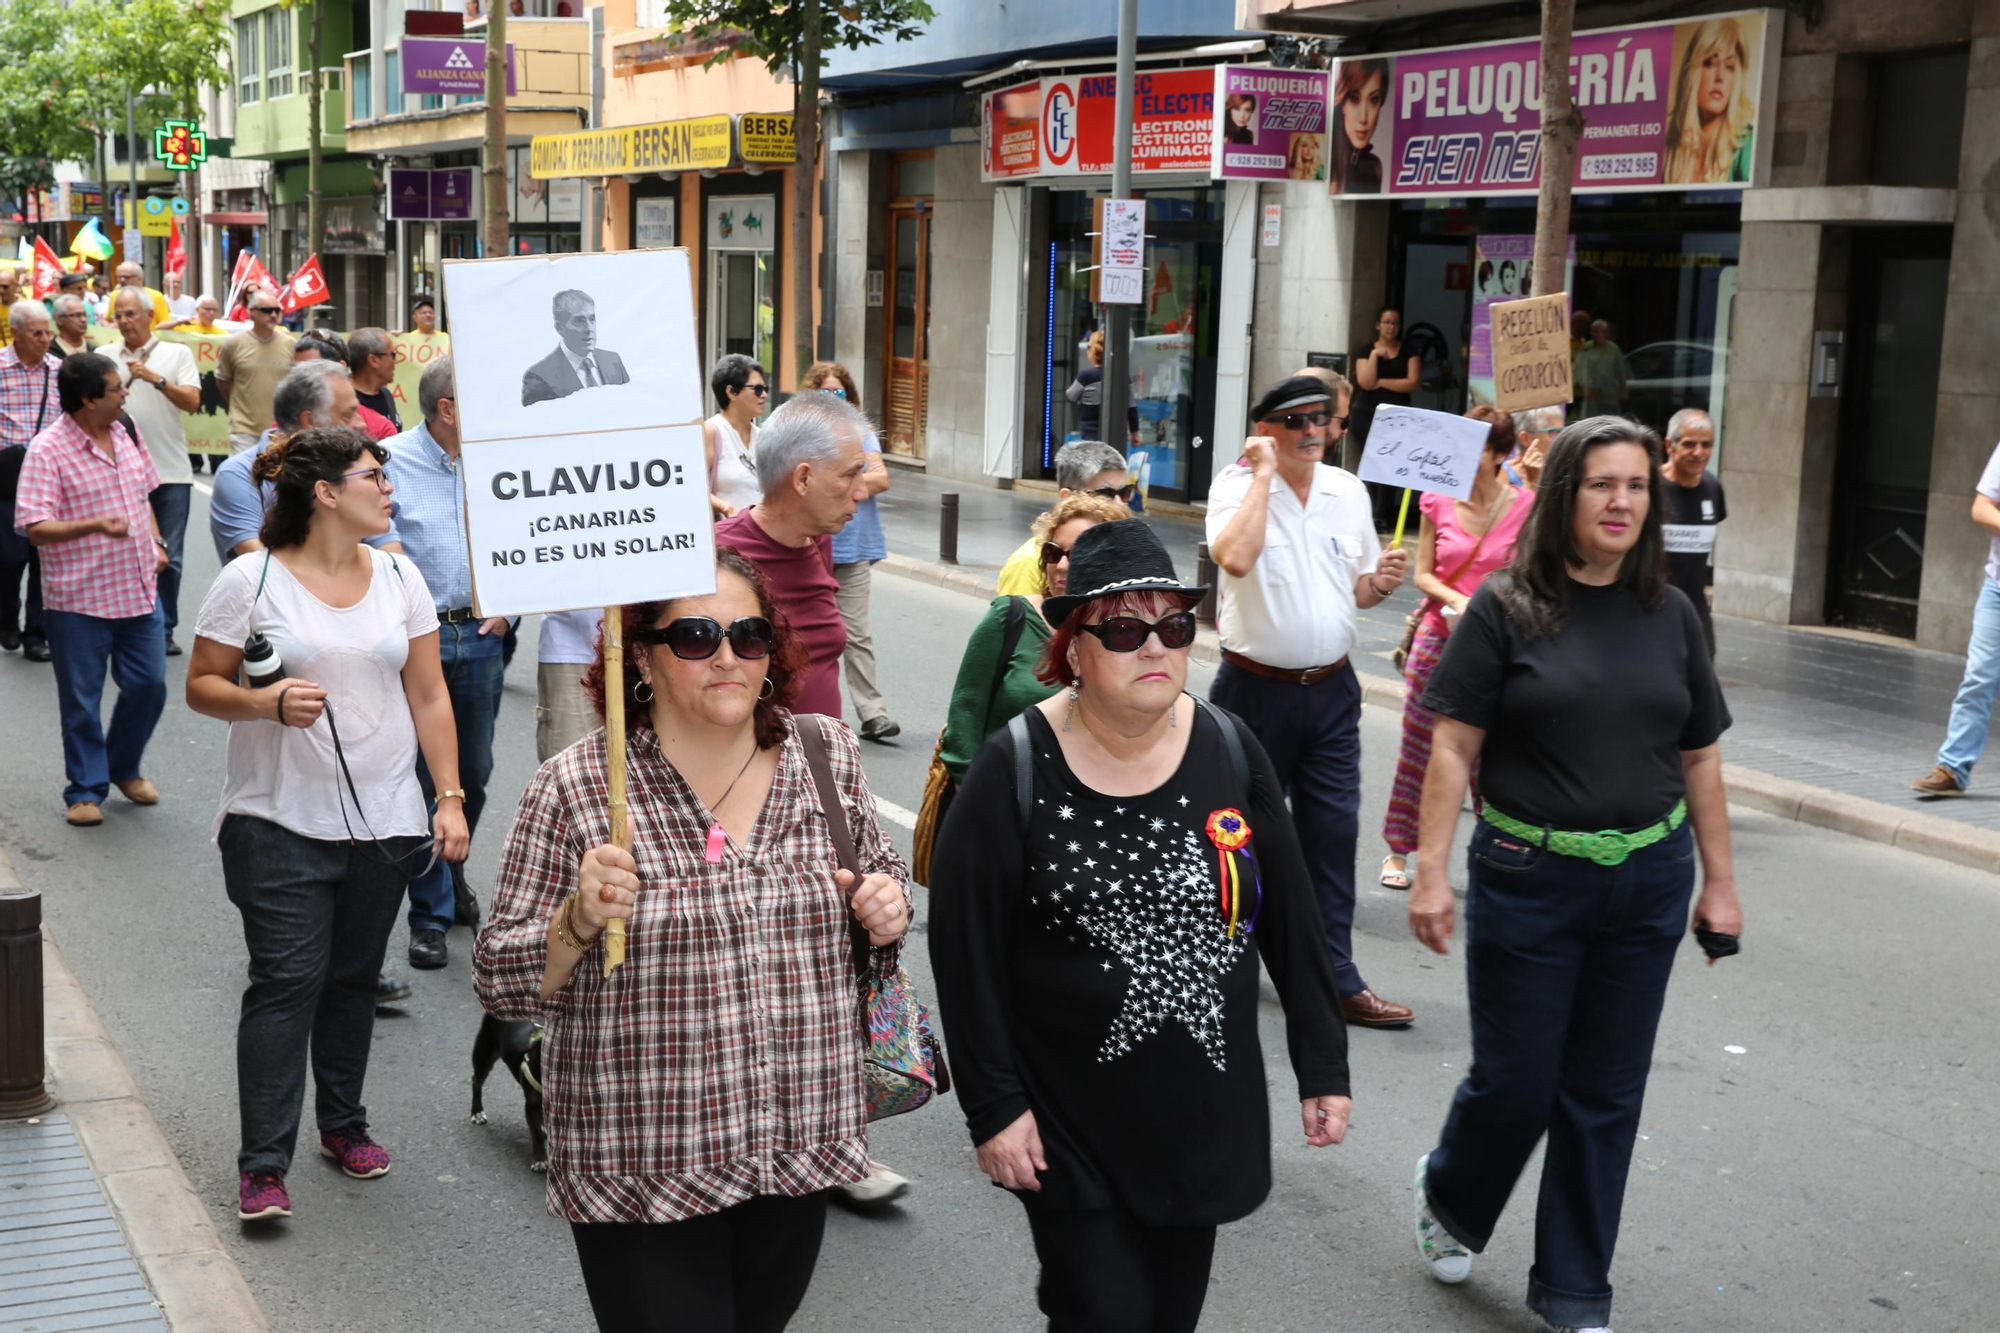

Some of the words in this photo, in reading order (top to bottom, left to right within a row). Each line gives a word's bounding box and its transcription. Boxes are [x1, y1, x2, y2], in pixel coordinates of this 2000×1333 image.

[416, 68, 458, 79] ALIANZA
[459, 70, 486, 81] CANA
[438, 81, 480, 89] FUNERARIA
[1080, 74, 1152, 98] ANEC
[1230, 75, 1323, 96] PELUQUERÍA
[1141, 92, 1214, 116] ELECTR
[1262, 97, 1324, 115] SHEN
[1132, 119, 1213, 134] LECTRONI
[1583, 125, 1639, 139] PERMANENTE
[1640, 123, 1662, 136] LISO
[533, 139, 569, 172] COMIDAS
[571, 133, 629, 171] PREPARADAS
[633, 123, 691, 167] BERSAN
[745, 150, 796, 159] CELEBRACIO
[1237, 155, 1252, 165] 928
[1252, 156, 1267, 166] 292
[1395, 132, 1484, 187] SHEN
[1593, 157, 1613, 174] 928
[1613, 156, 1634, 173] 292
[1634, 155, 1655, 172] 985
[490, 458, 684, 501] CLAVIJO:
[528, 506, 656, 538] ¡CANARIAS
[491, 549, 527, 568] NO
[534, 545, 565, 564] ES
[572, 541, 607, 560] UN
[614, 532, 697, 557] SOLAR!
